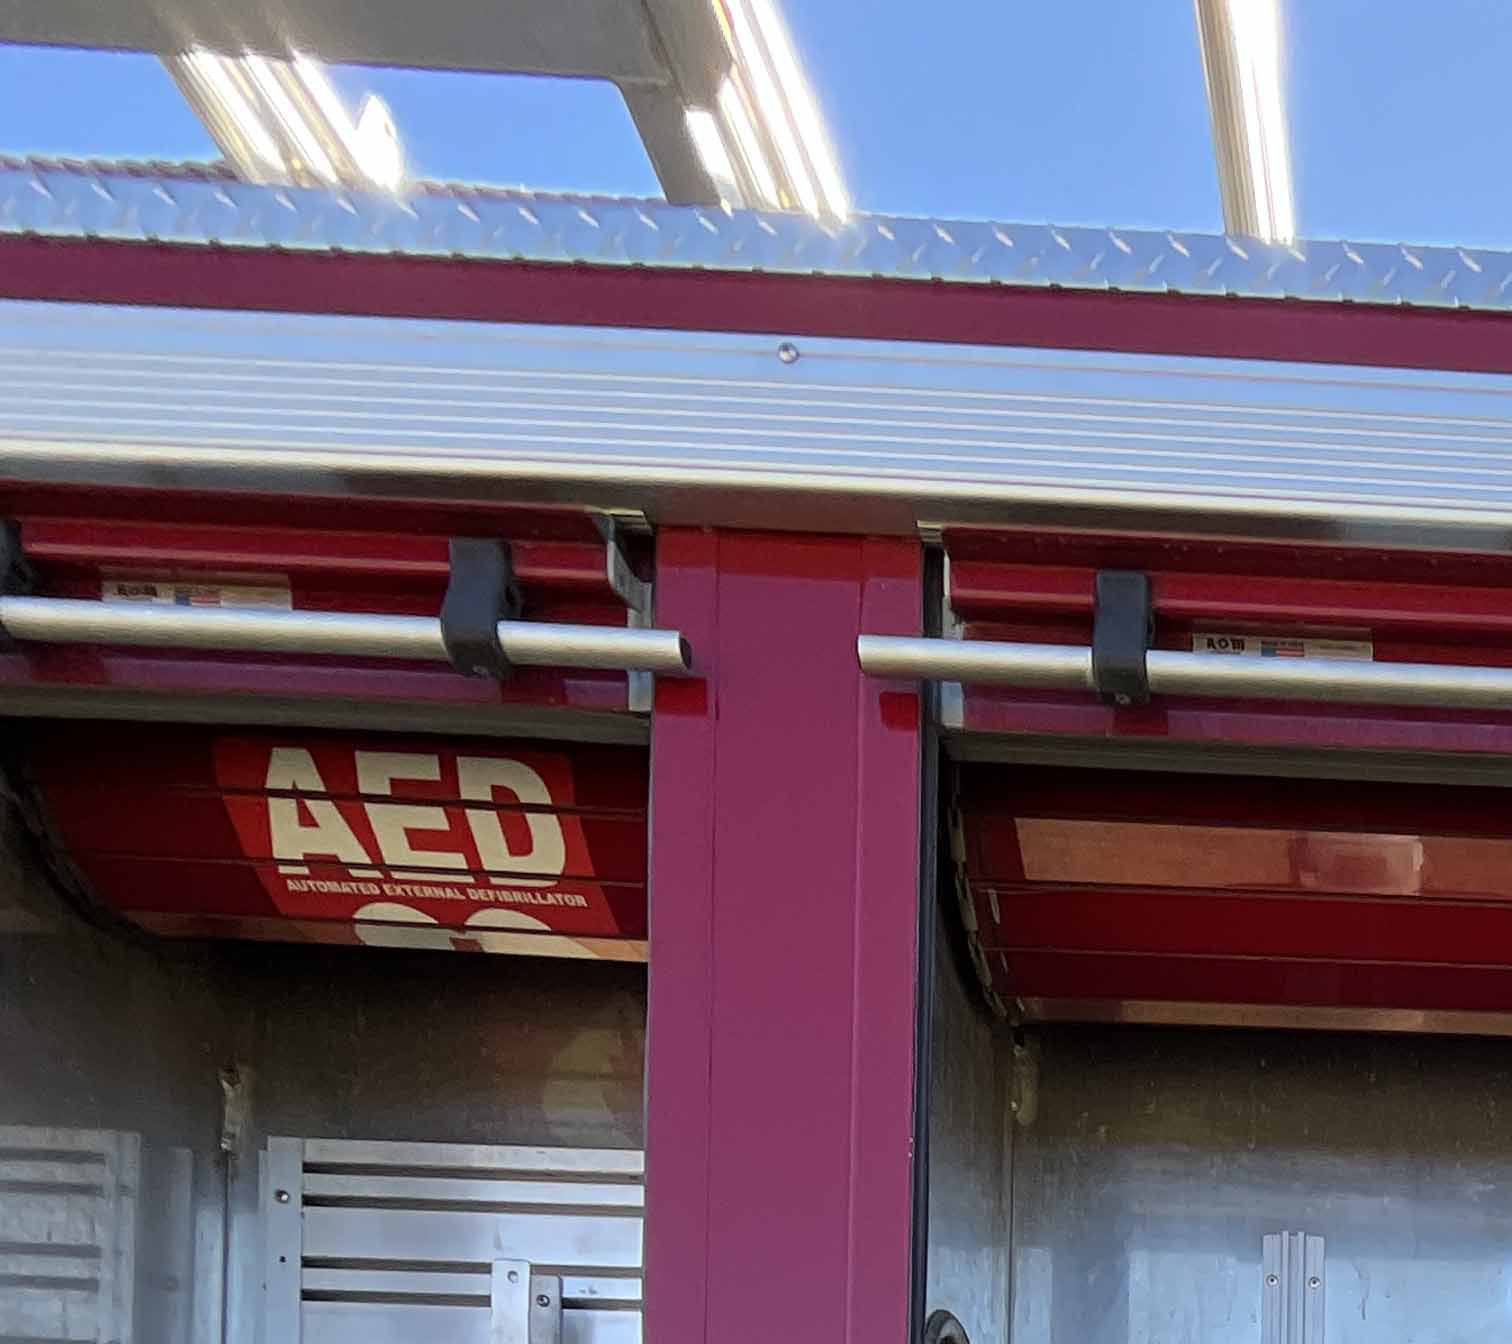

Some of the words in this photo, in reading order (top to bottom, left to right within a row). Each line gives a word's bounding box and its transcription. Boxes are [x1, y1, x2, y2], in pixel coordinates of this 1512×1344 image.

[265, 747, 565, 887] AED
[286, 879, 381, 896] AUTOMATED
[383, 883, 466, 900] EXTERNAL
[465, 888, 588, 908] DEFIBRILLATOR
